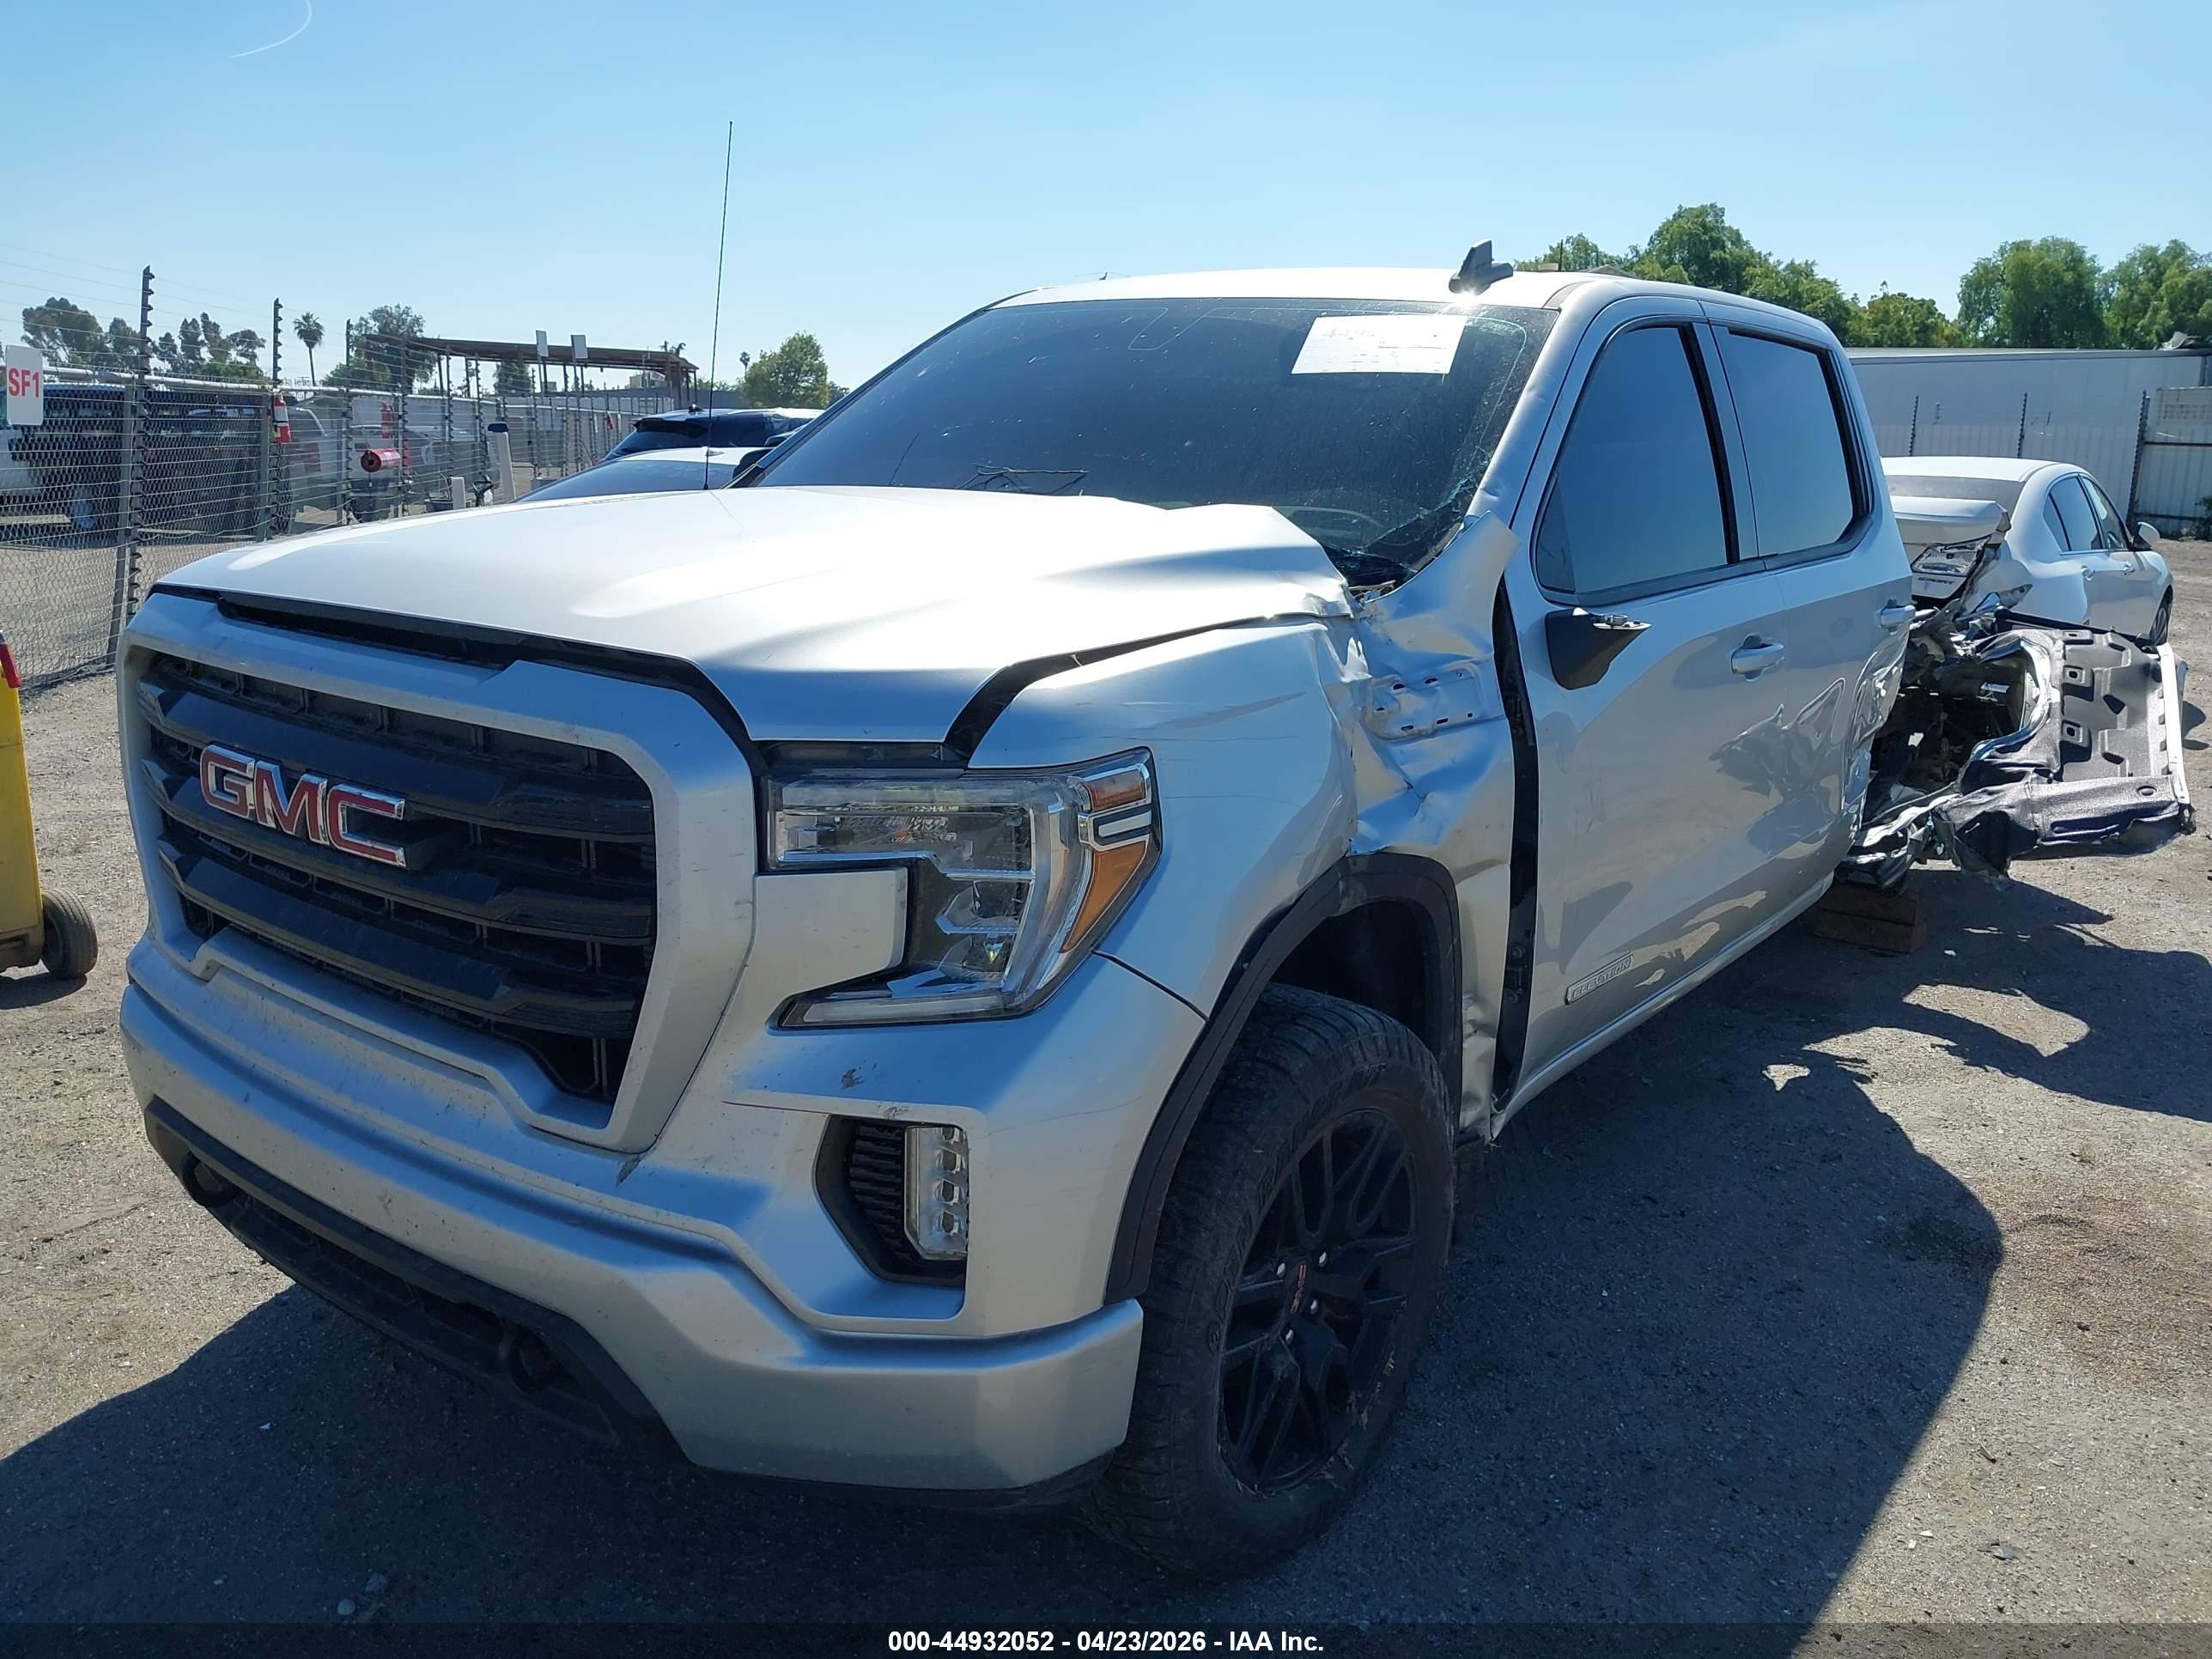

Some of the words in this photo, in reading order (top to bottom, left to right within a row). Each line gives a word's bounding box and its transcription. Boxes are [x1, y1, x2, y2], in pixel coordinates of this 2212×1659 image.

[8, 367, 40, 398] SF1
[199, 743, 407, 868] GMC
[1572, 956, 1631, 998] ELEVATION
